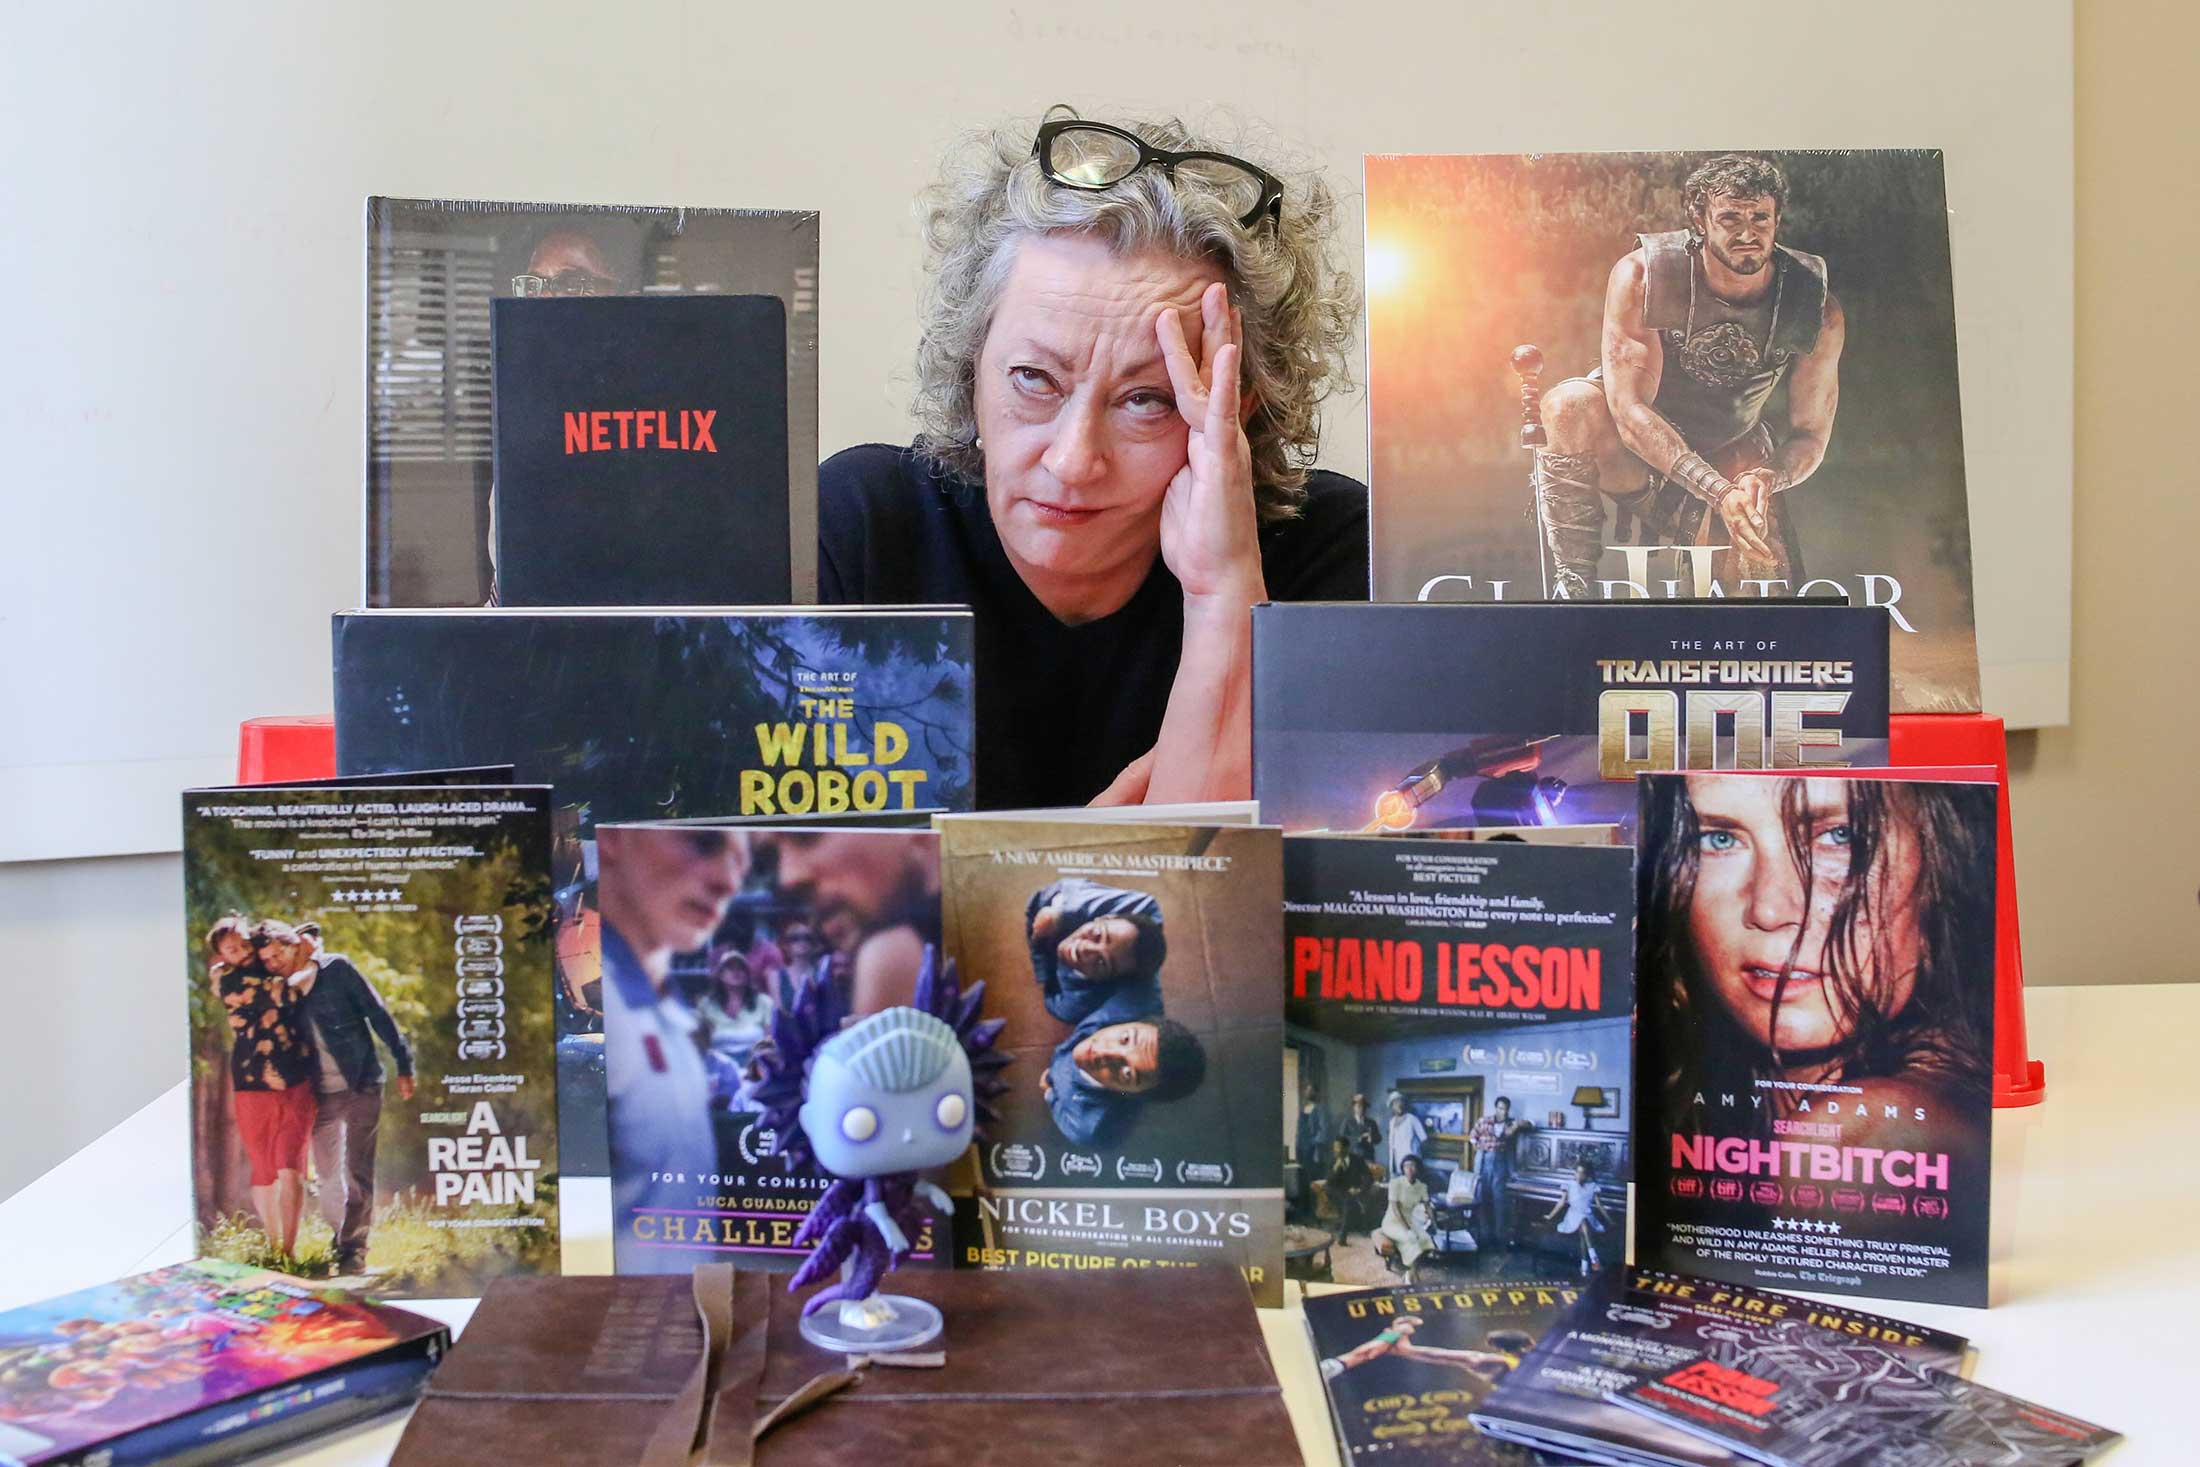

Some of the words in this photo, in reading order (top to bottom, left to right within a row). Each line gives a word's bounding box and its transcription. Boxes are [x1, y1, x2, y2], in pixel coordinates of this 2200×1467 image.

[564, 409, 718, 455] NETFLIX
[1671, 640, 1702, 650] THE
[1713, 640, 1745, 650] ART
[1757, 640, 1777, 650] OF
[797, 673, 817, 681] THE
[820, 672, 839, 681] ART
[843, 672, 857, 681] OF
[1597, 660, 1853, 684] TRANSFORMERS
[800, 699, 854, 719] THE
[755, 721, 909, 767] WILD
[1599, 689, 1852, 781] ONE
[740, 769, 928, 816] ROBOT
[278, 804, 354, 815] BEAUTIFULLY
[1006, 852, 1042, 865] NEW
[1046, 852, 1122, 868] AMERICAN
[1413, 872, 1437, 882] BEST
[1438, 873, 1480, 884] PICTURE
[1323, 902, 1384, 916] MALCOLM
[1385, 905, 1468, 919] WASHINGTON
[1469, 907, 1490, 919] hits
[1490, 911, 1518, 924] every
[1519, 912, 1543, 923] note
[1544, 912, 1556, 923] to
[1435, 893, 1488, 908] friendship
[1489, 896, 1509, 908] and
[1437, 942, 1601, 1011] LESSON
[1755, 1079, 1772, 1088] FOR
[1773, 1080, 1796, 1090] YOUR
[1797, 1082, 1864, 1095] CONSIDERATION
[466, 1101, 500, 1135] A
[1694, 1092, 1762, 1108] AMY
[1799, 1100, 1926, 1120] ADAMS
[1773, 1120, 1843, 1137] SEARCHLIGHT
[428, 1136, 541, 1171] REAL
[1671, 1133, 1949, 1190] NIGHTBITCH
[435, 1170, 535, 1206] PAIN
[652, 1172, 686, 1183] FOR
[698, 1174, 746, 1187] YOUR
[757, 1176, 840, 1189] CONSID
[697, 1196, 737, 1208] LUCA
[978, 1197, 1125, 1229] NICKEL
[1144, 1207, 1251, 1238] BOYS
[1002, 1225, 1021, 1234] FOR
[1024, 1227, 1048, 1236] YOUR
[1052, 1229, 1129, 1242] CONSIDERATION
[1131, 1234, 1142, 1243] IN
[1743, 1230, 1803, 1244] UNLEASHES
[1804, 1234, 1864, 1249] SOMETHING
[1866, 1239, 1898, 1252] TRULY
[1899, 1243, 1951, 1257] PRIMEVAL
[967, 1247, 1019, 1265] BEST
[1672, 1234, 1694, 1245] AND
[1696, 1236, 1722, 1248] WILD
[1724, 1239, 1735, 1249] IN
[1736, 1240, 1759, 1251] AMY
[1801, 1246, 1840, 1258] HELLER
[1841, 1249, 1852, 1258] IS
[1853, 1251, 1861, 1260] A
[1863, 1252, 1906, 1264] PROVEN
[1907, 1256, 1950, 1268] MASTER
[1696, 1247, 1712, 1258] OF
[1713, 1249, 1733, 1260] THE
[1734, 1251, 1769, 1263] RICHLY
[1770, 1254, 1824, 1268] TEXTURED
[1825, 1260, 1888, 1275] CHARACTER
[1635, 1277, 1697, 1298] THE
[1711, 1291, 1789, 1317] FIRE
[1806, 1311, 1925, 1348] INSIDE
